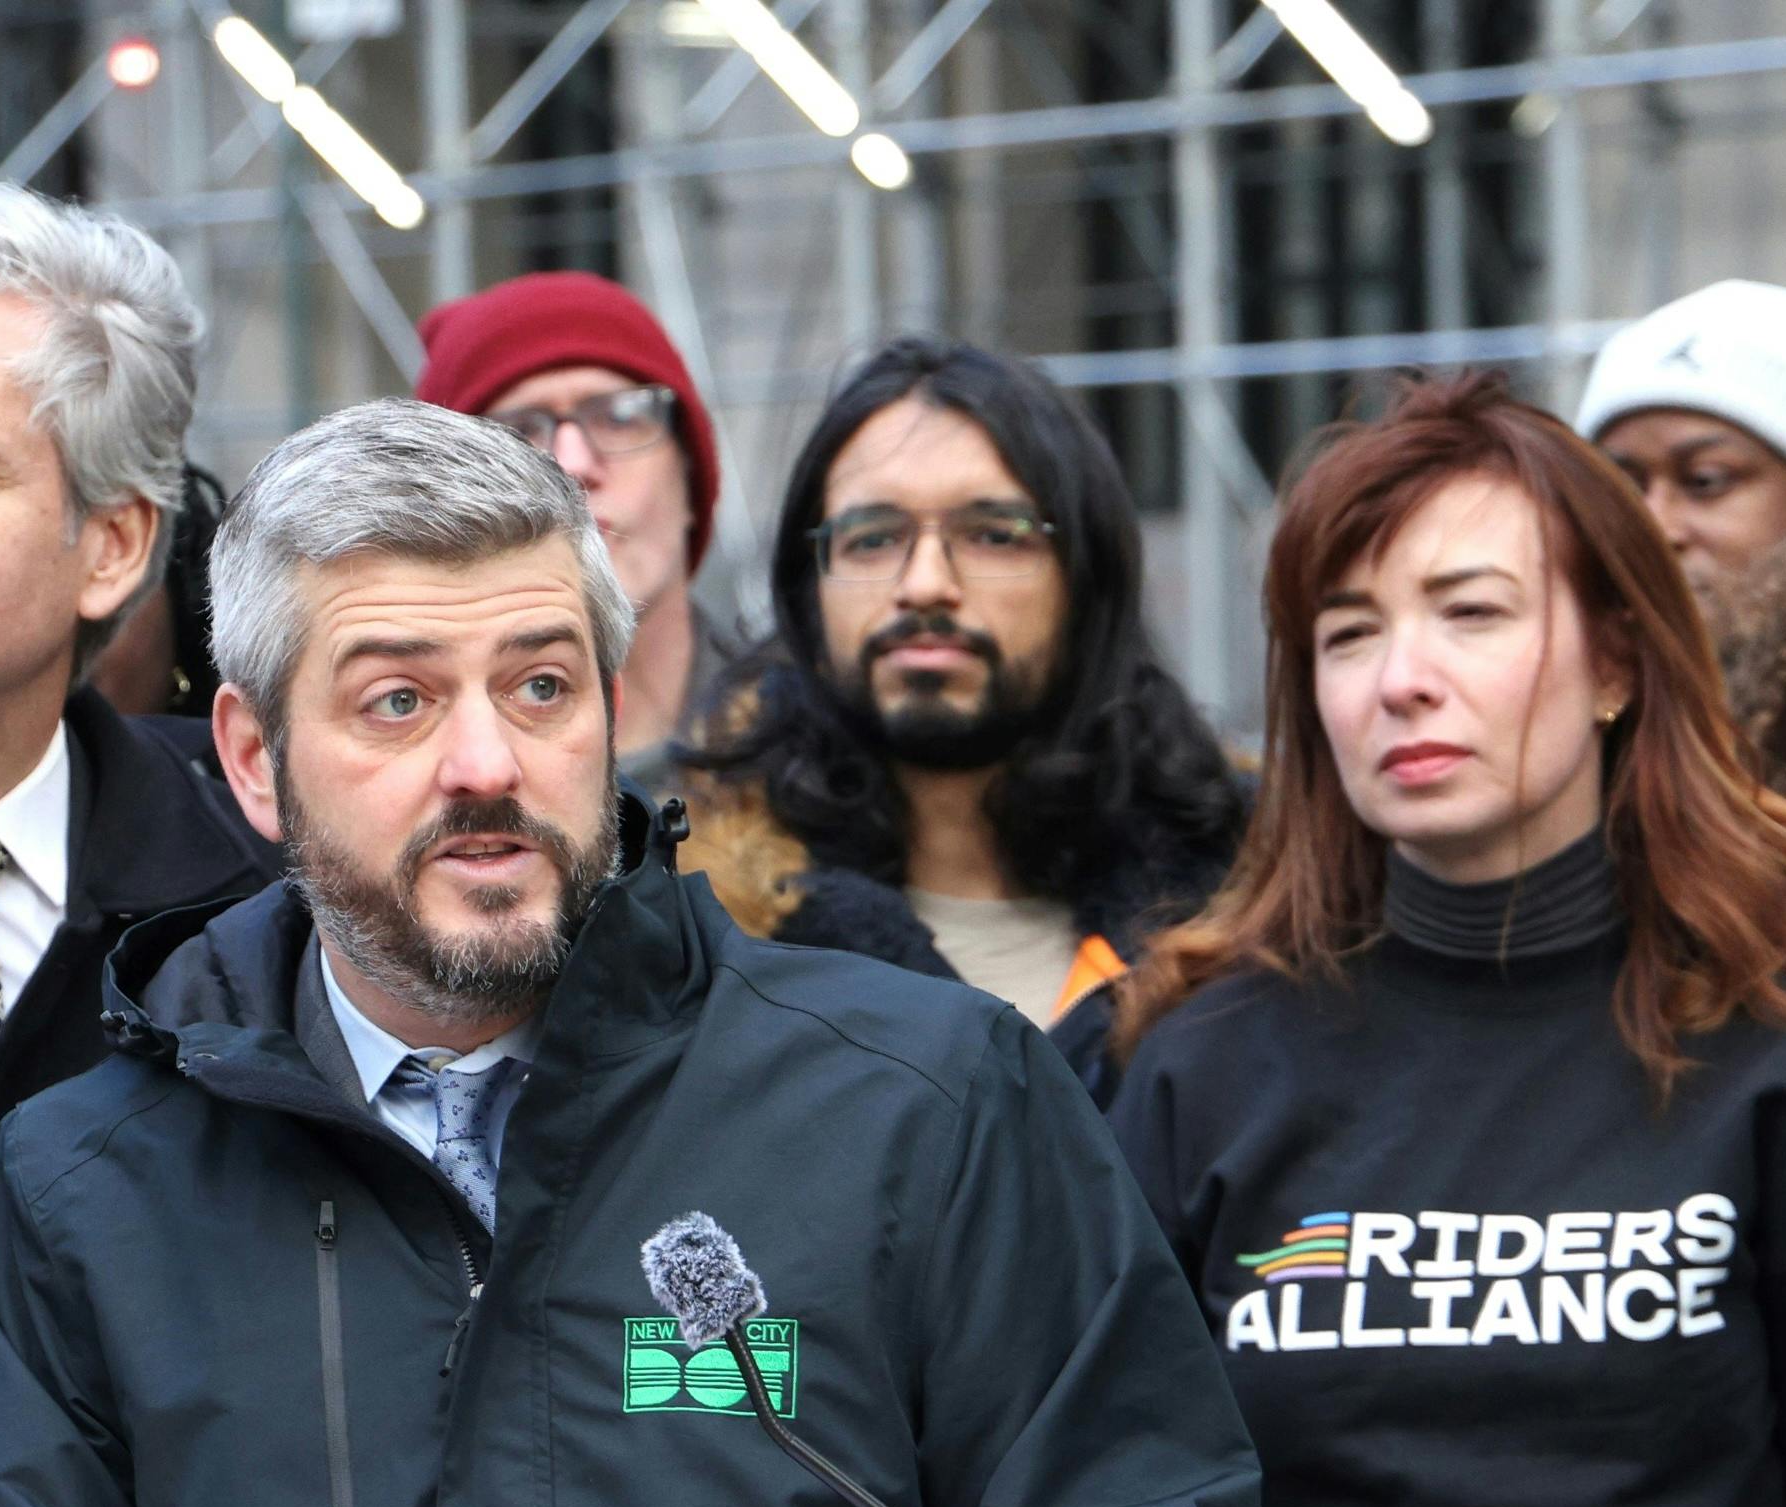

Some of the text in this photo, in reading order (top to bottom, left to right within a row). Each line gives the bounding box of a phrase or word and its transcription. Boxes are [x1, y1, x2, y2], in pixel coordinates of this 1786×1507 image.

[1347, 1192, 1736, 1279] RIDERS
[631, 1322, 791, 1343] NEW CITY
[1226, 1268, 1726, 1353] ALLIANCE
